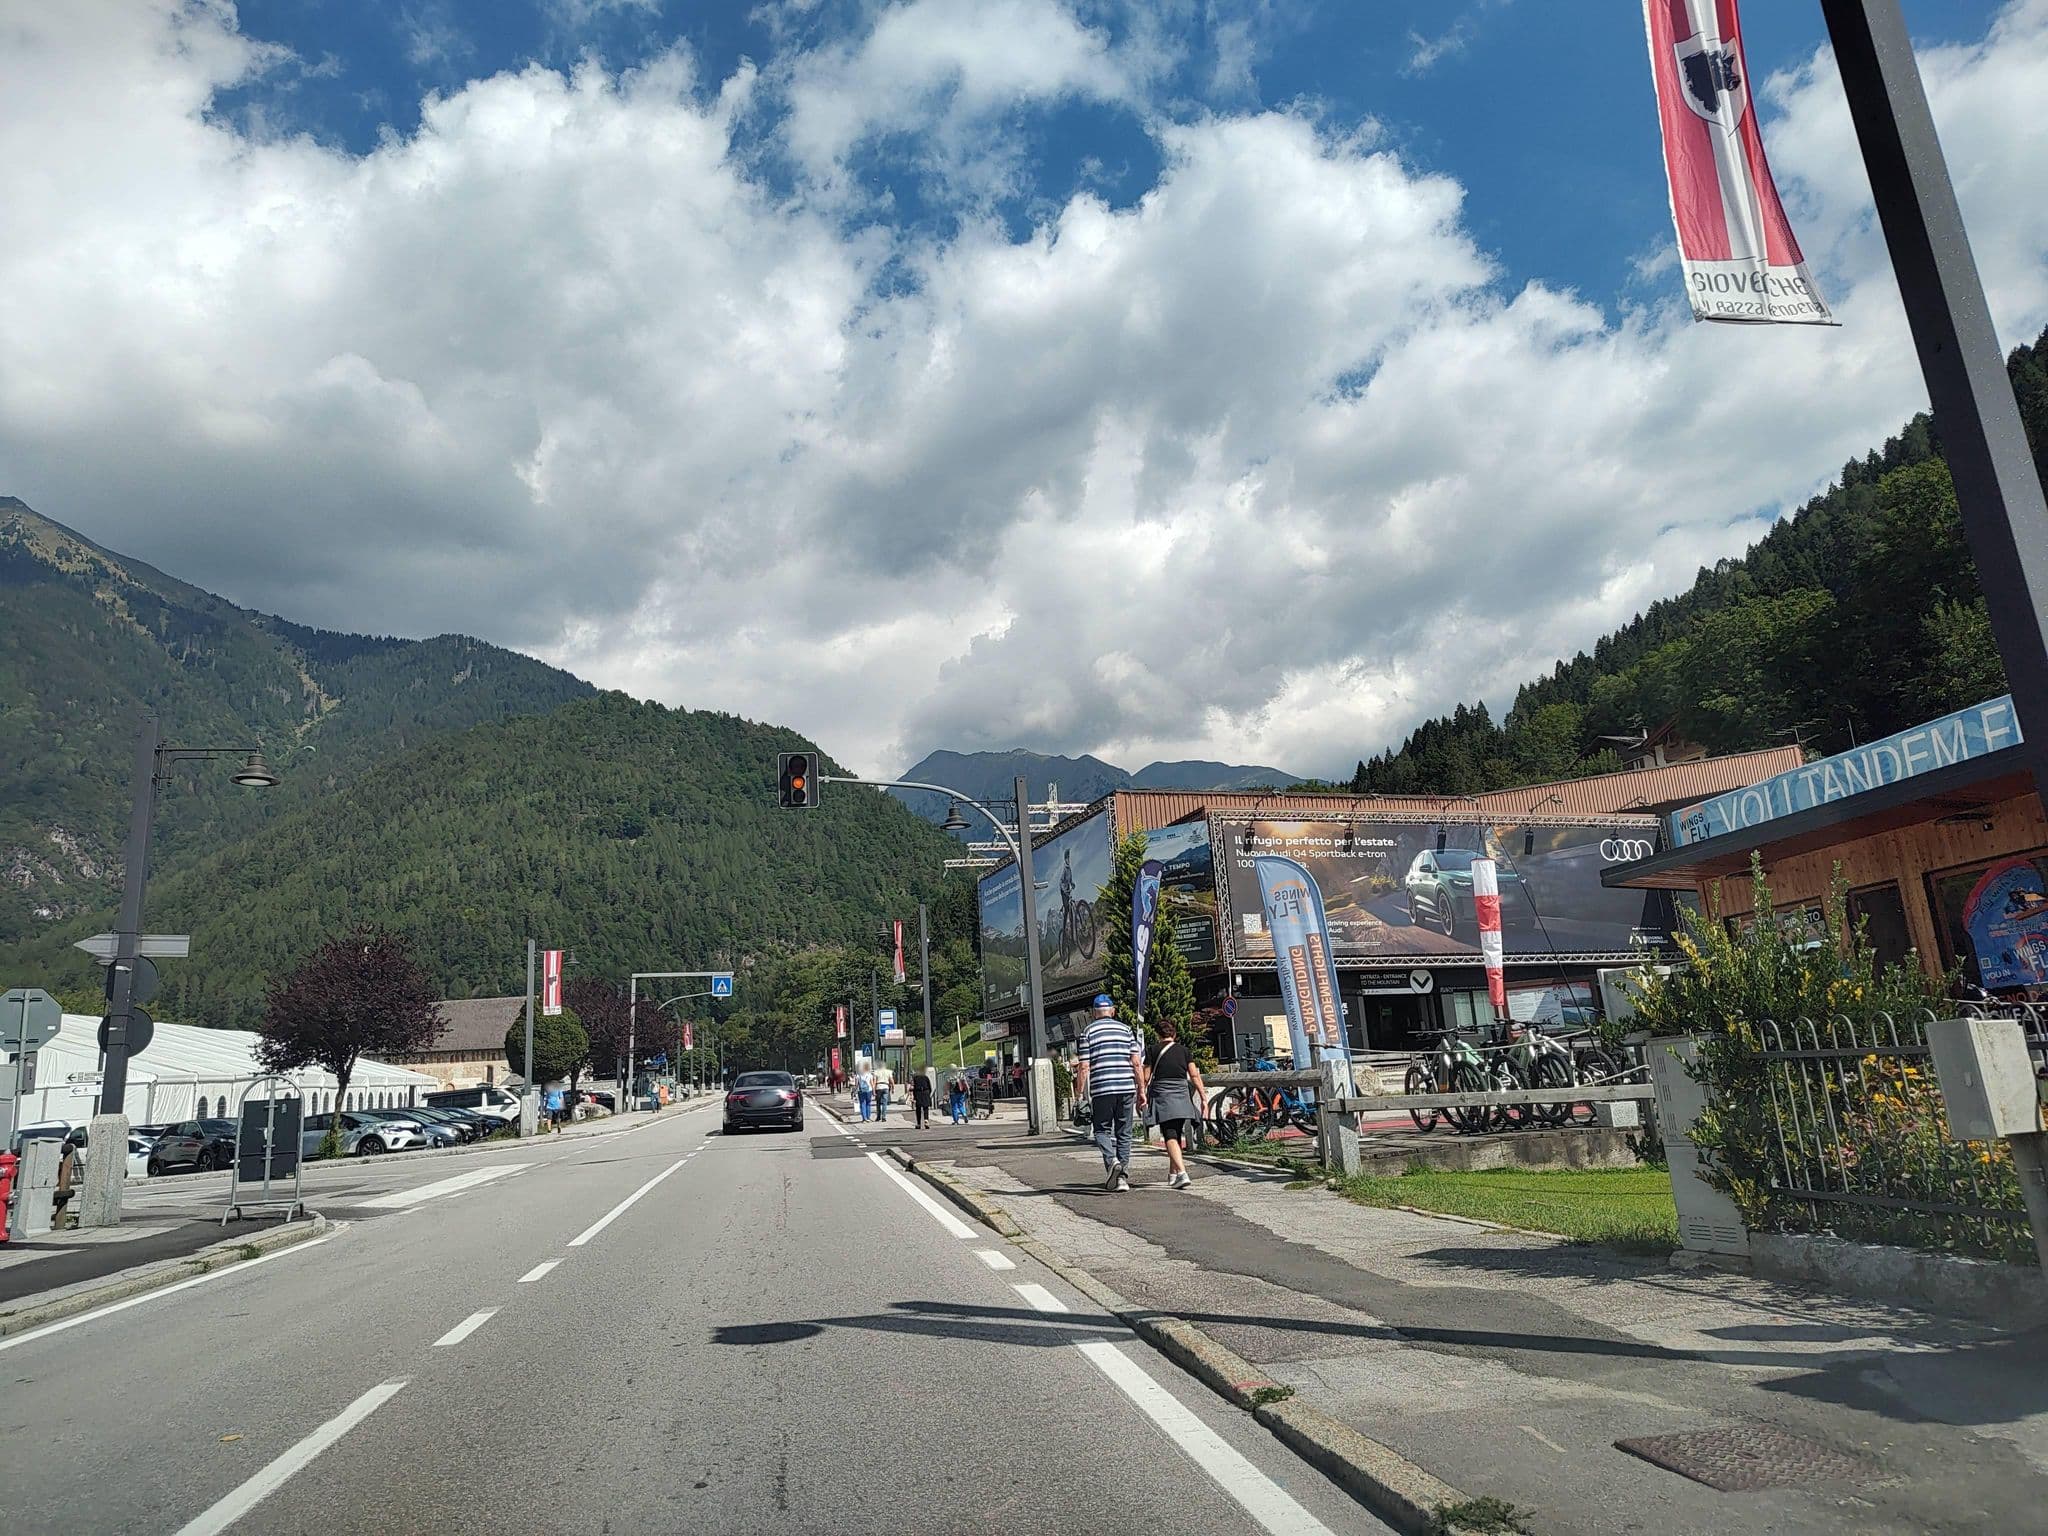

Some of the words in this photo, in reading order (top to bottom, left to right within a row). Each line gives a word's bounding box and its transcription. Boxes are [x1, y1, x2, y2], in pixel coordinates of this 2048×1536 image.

[1799, 719, 1969, 807] TANDEM
[1679, 812, 1704, 832] WINGS
[1690, 822, 1712, 842] FLY
[1245, 836, 1283, 847] rifugio
[1285, 836, 1332, 847] perfetto
[1335, 838, 1352, 847] per
[1355, 837, 1398, 847] l'estate.
[1269, 849, 1291, 857] Audi
[1293, 850, 1306, 858] Q4
[1308, 850, 1357, 859] Sportback
[1358, 850, 1387, 858] e-tron
[1327, 919, 1349, 927] driving
[1784, 911, 1820, 928] BIPSTO
[2013, 940, 2046, 960] WINGS
[2029, 954, 2048, 971] FL
